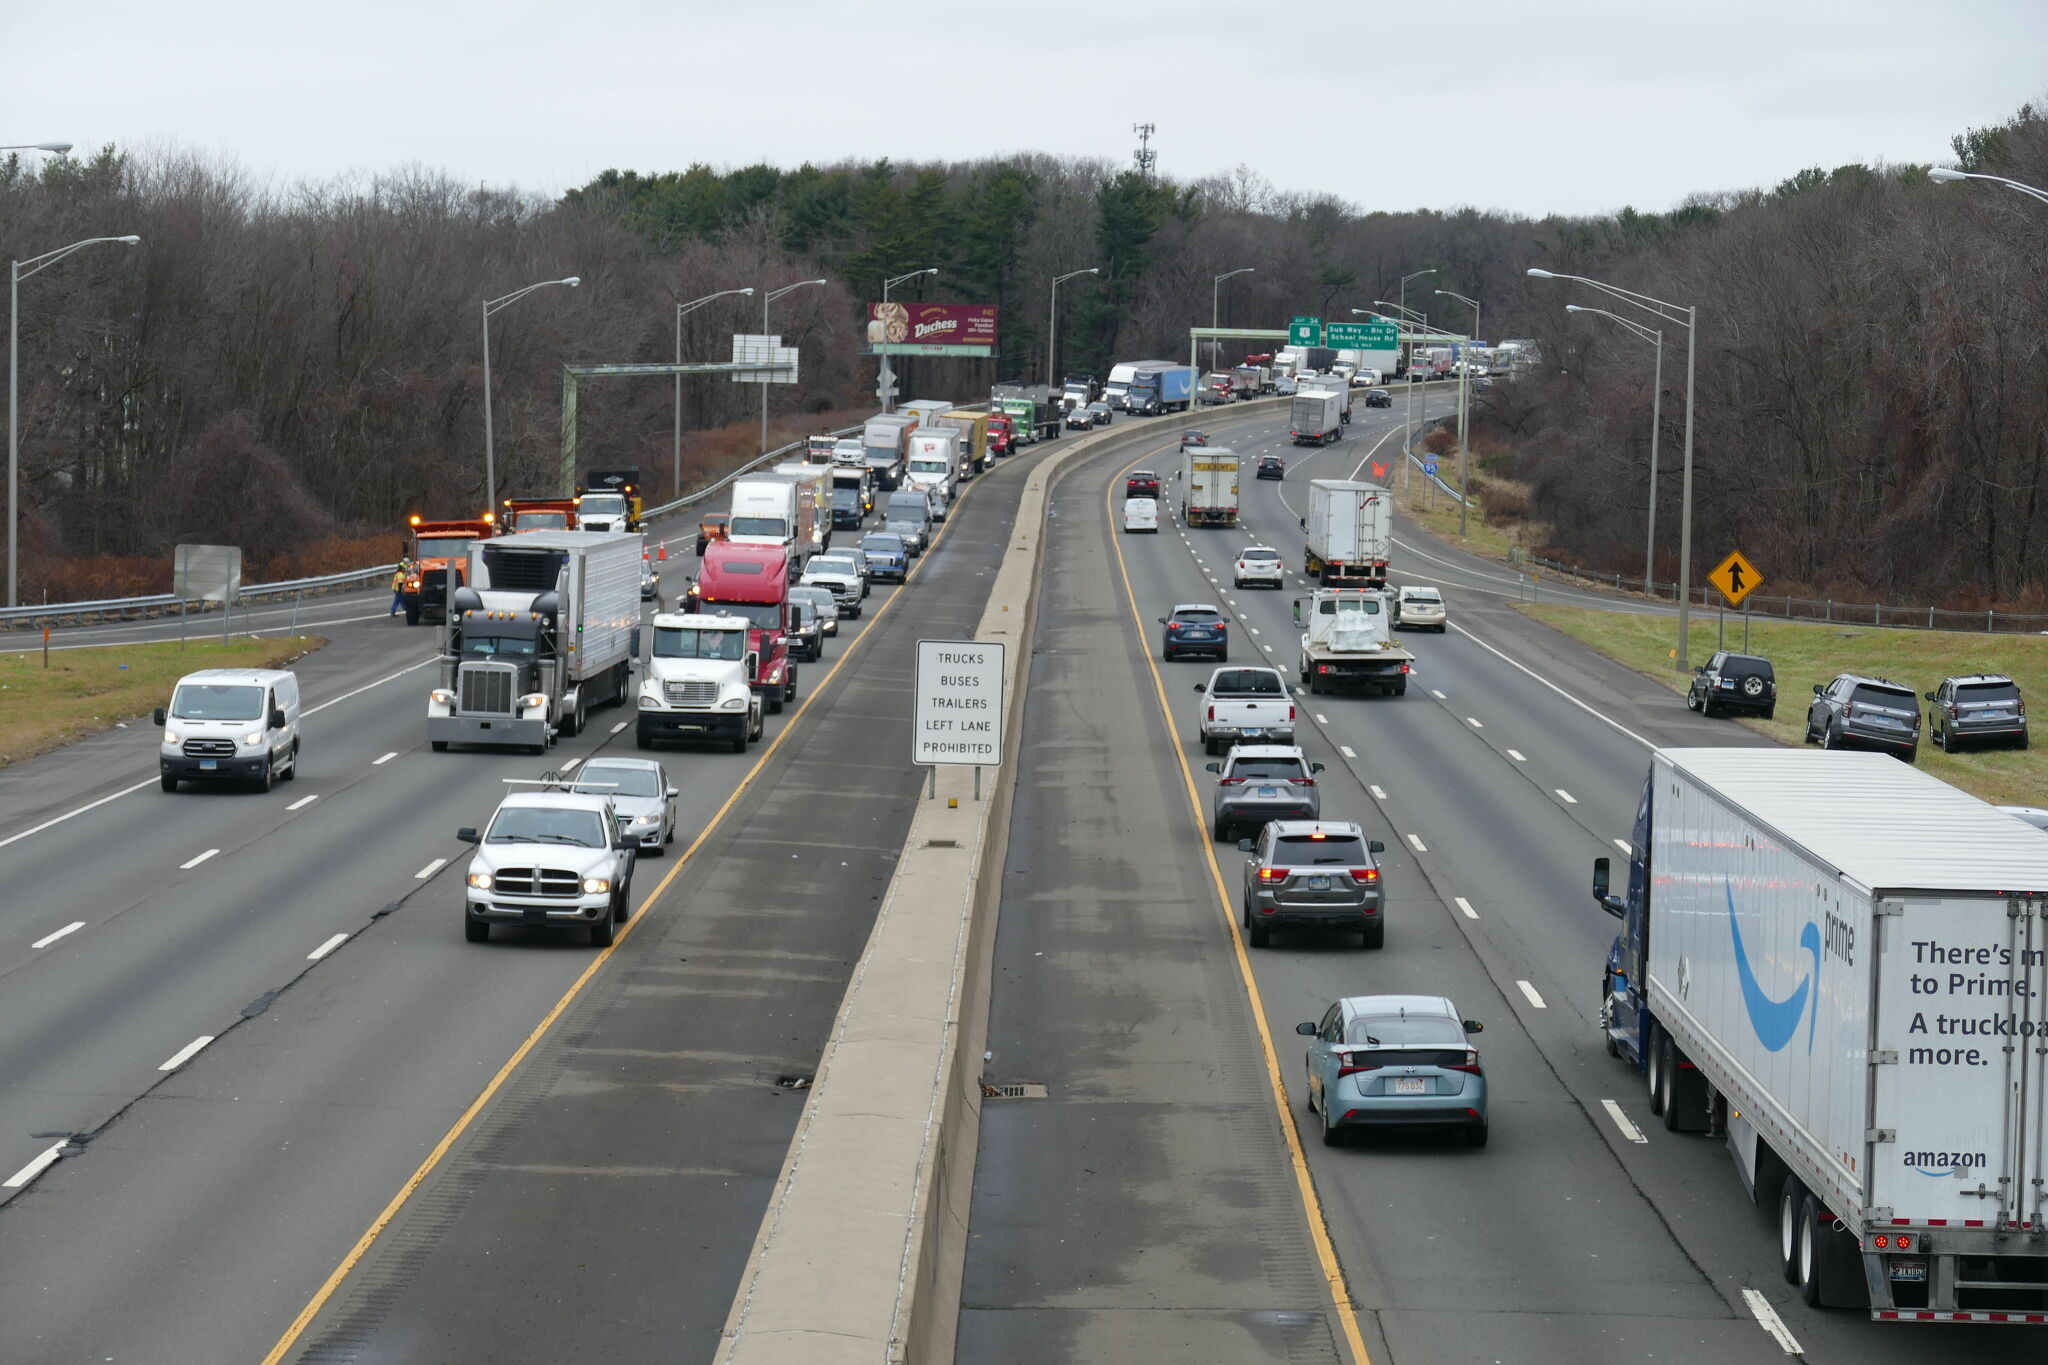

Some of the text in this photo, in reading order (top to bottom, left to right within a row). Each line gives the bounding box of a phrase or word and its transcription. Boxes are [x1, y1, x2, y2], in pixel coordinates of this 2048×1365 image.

[914, 319, 958, 338] Duchess
[1347, 326, 1362, 334] Way
[1425, 464, 1436, 473] 95
[938, 653, 984, 664] TRUCKS
[941, 676, 980, 686] BUSES
[932, 697, 987, 709] TRAILERS
[926, 720, 991, 732] LEFT LANE
[923, 742, 993, 754] PROHIBITED
[1824, 900, 1855, 968] prime
[1911, 941, 2012, 966] There's
[1910, 972, 2037, 998] to Prime.
[1908, 1012, 1929, 1034] A
[1909, 1047, 1988, 1066] more.
[1903, 1151, 1987, 1168] amazon
